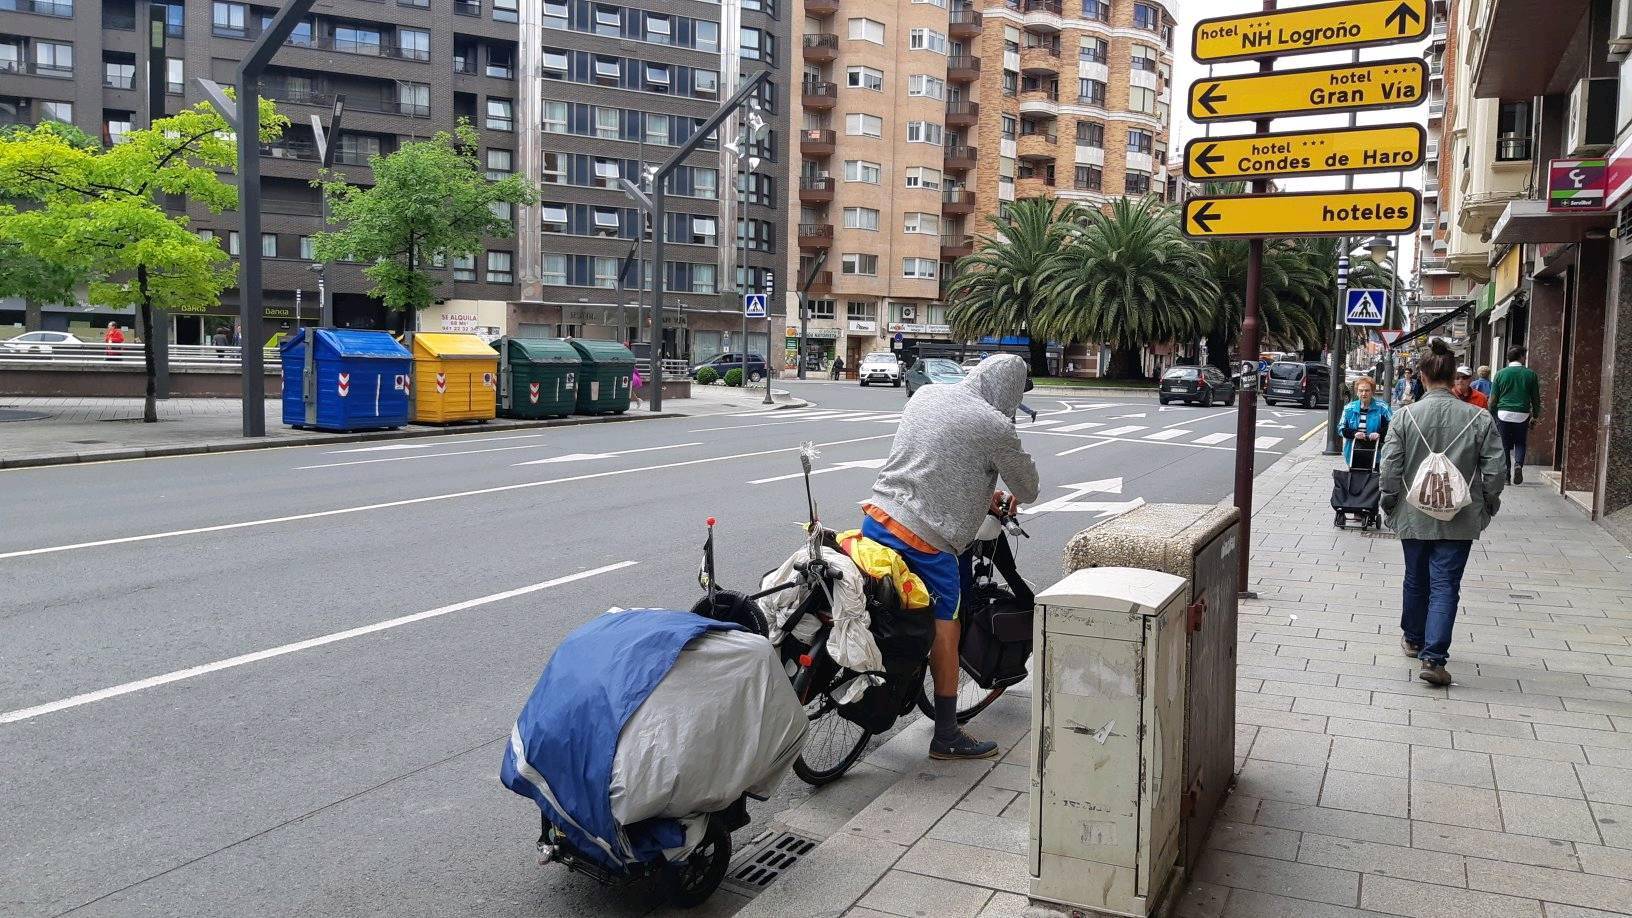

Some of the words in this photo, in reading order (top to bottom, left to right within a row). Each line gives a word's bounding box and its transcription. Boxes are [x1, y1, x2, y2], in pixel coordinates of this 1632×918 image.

[1201, 25, 1239, 40] hotel
[1242, 30, 1271, 48] NH
[1278, 21, 1361, 46] Logroño
[1330, 70, 1372, 85] hotel
[1310, 87, 1364, 105] Gran
[1381, 80, 1416, 100] Vía
[1252, 142, 1291, 155] hotel
[1238, 156, 1311, 172] Condes
[1325, 153, 1349, 167] de
[1363, 149, 1413, 165] Haro
[1322, 203, 1409, 222] hoteles
